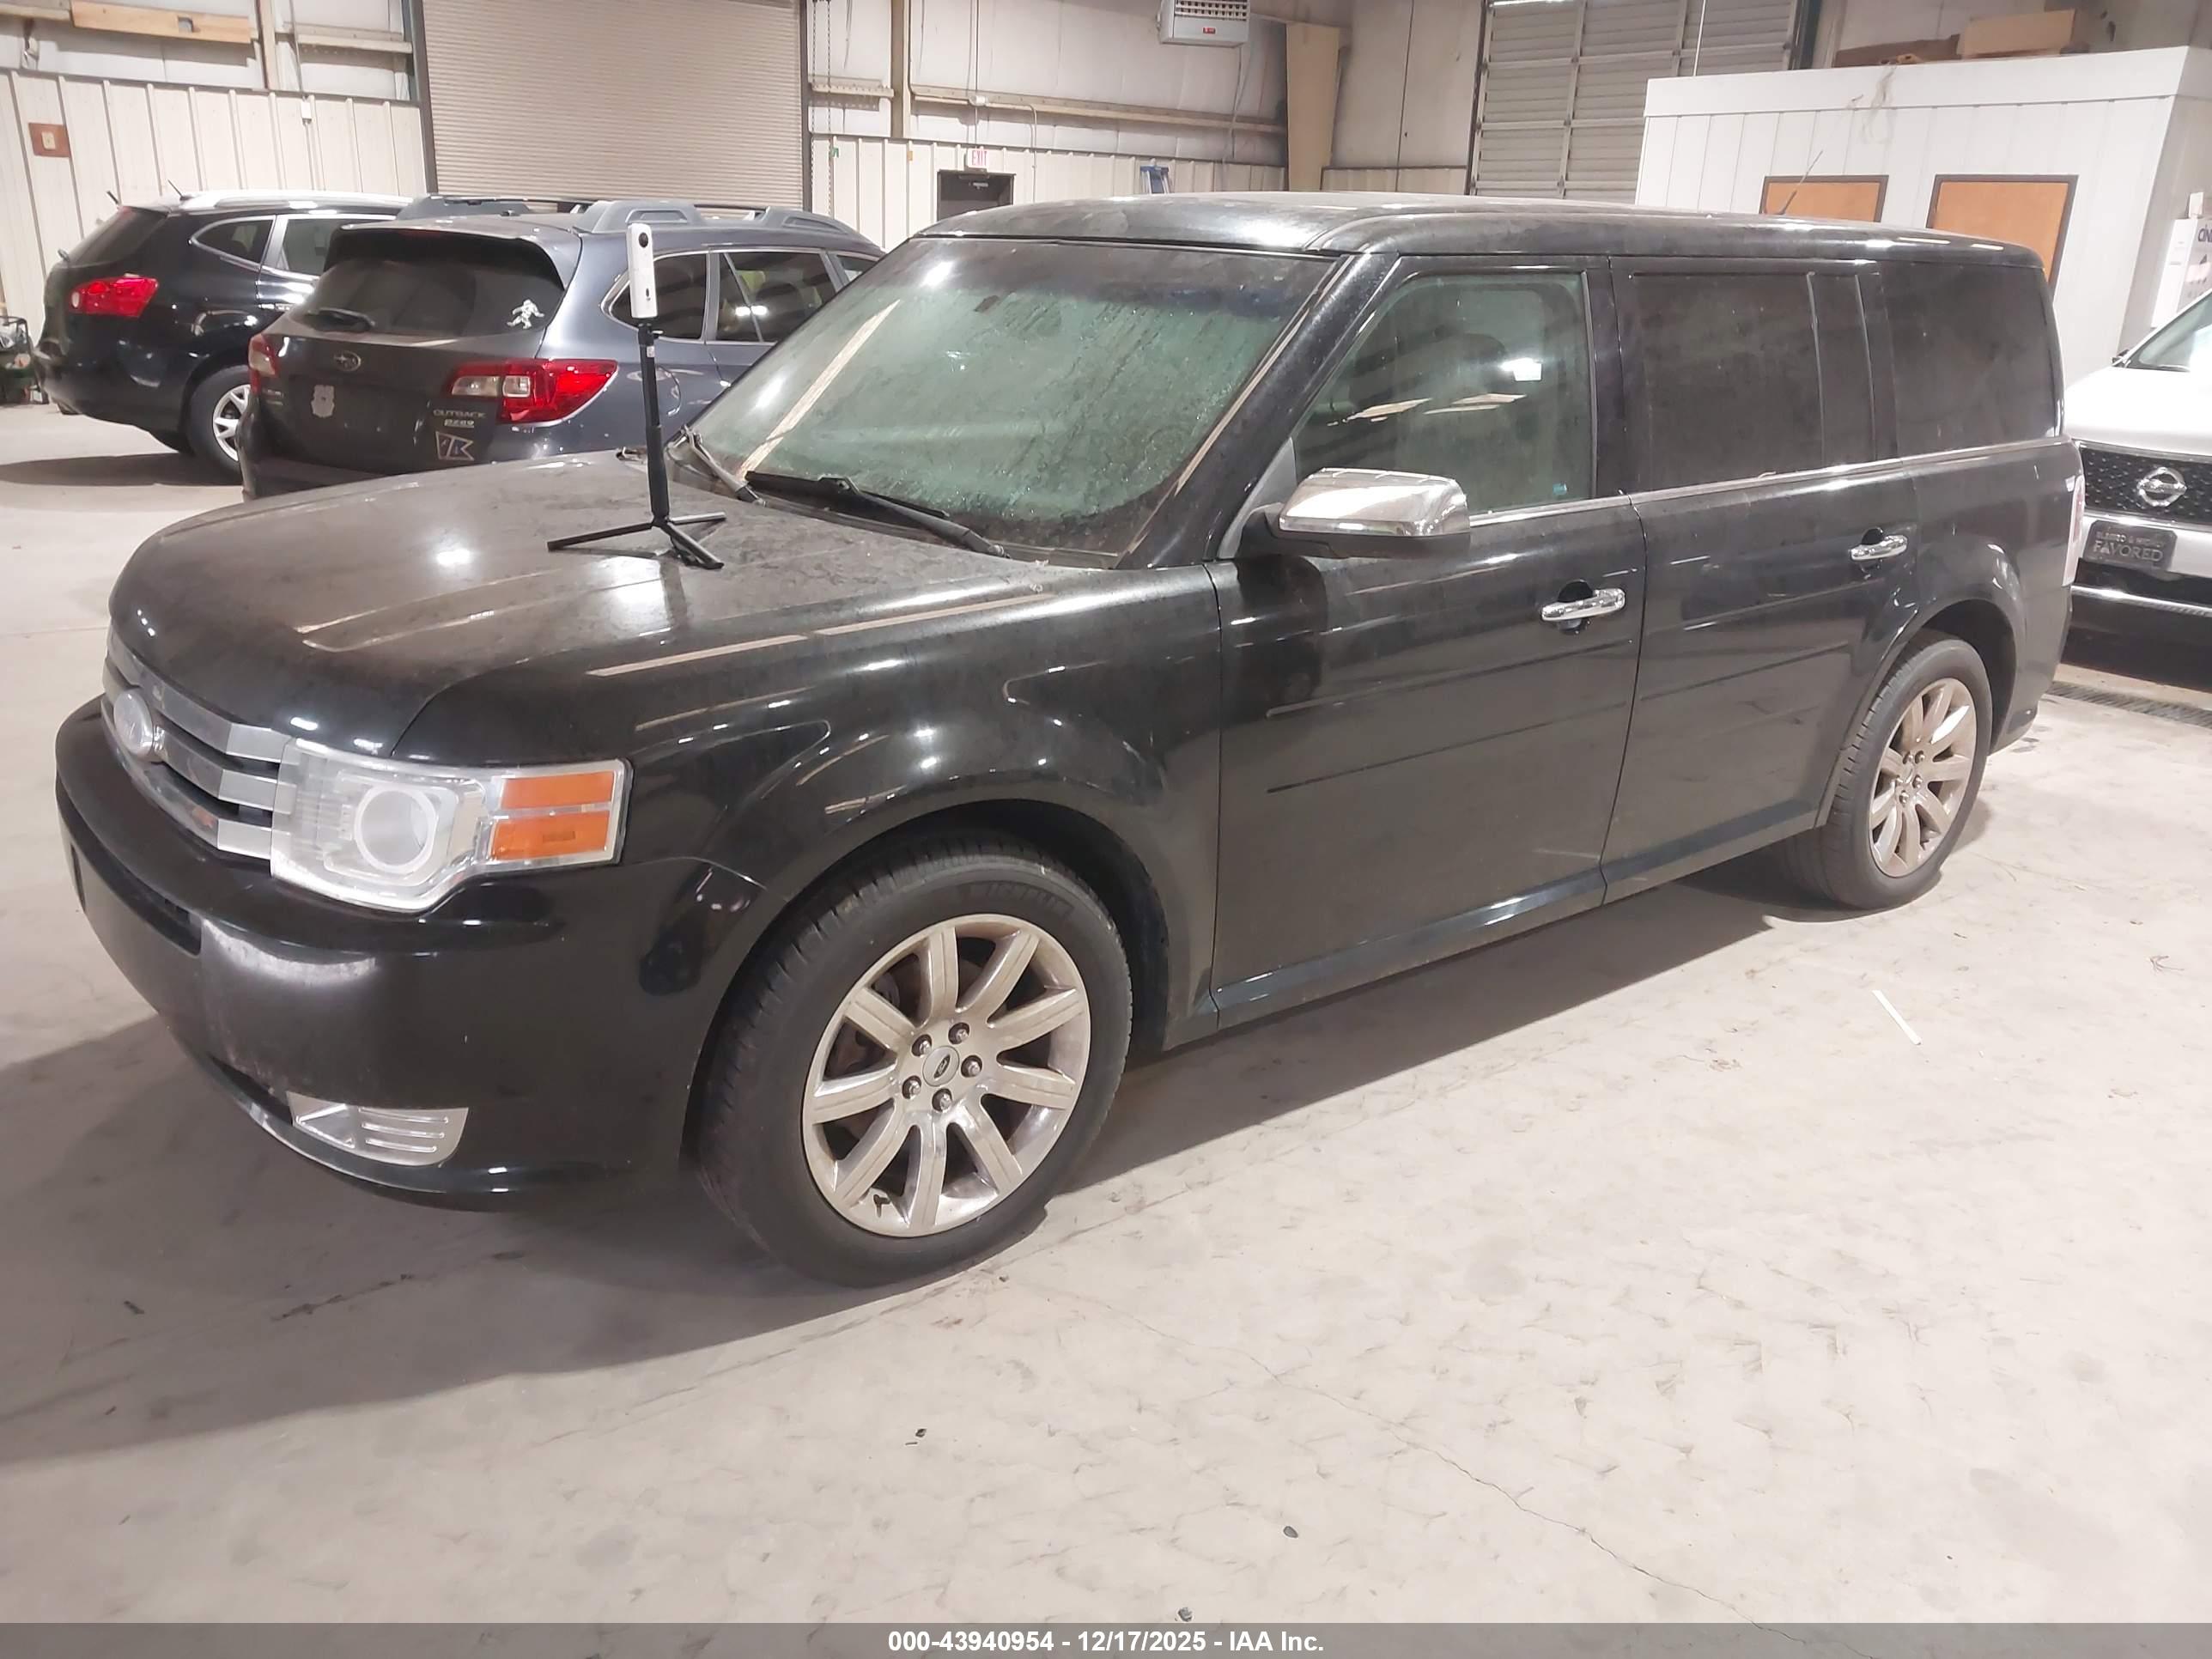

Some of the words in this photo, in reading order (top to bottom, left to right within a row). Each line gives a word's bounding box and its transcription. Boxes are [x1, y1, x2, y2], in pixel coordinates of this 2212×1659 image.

[971, 149, 988, 167] EXIT
[433, 409, 486, 419] OUTBACK
[2094, 540, 2164, 562] FAVORED
